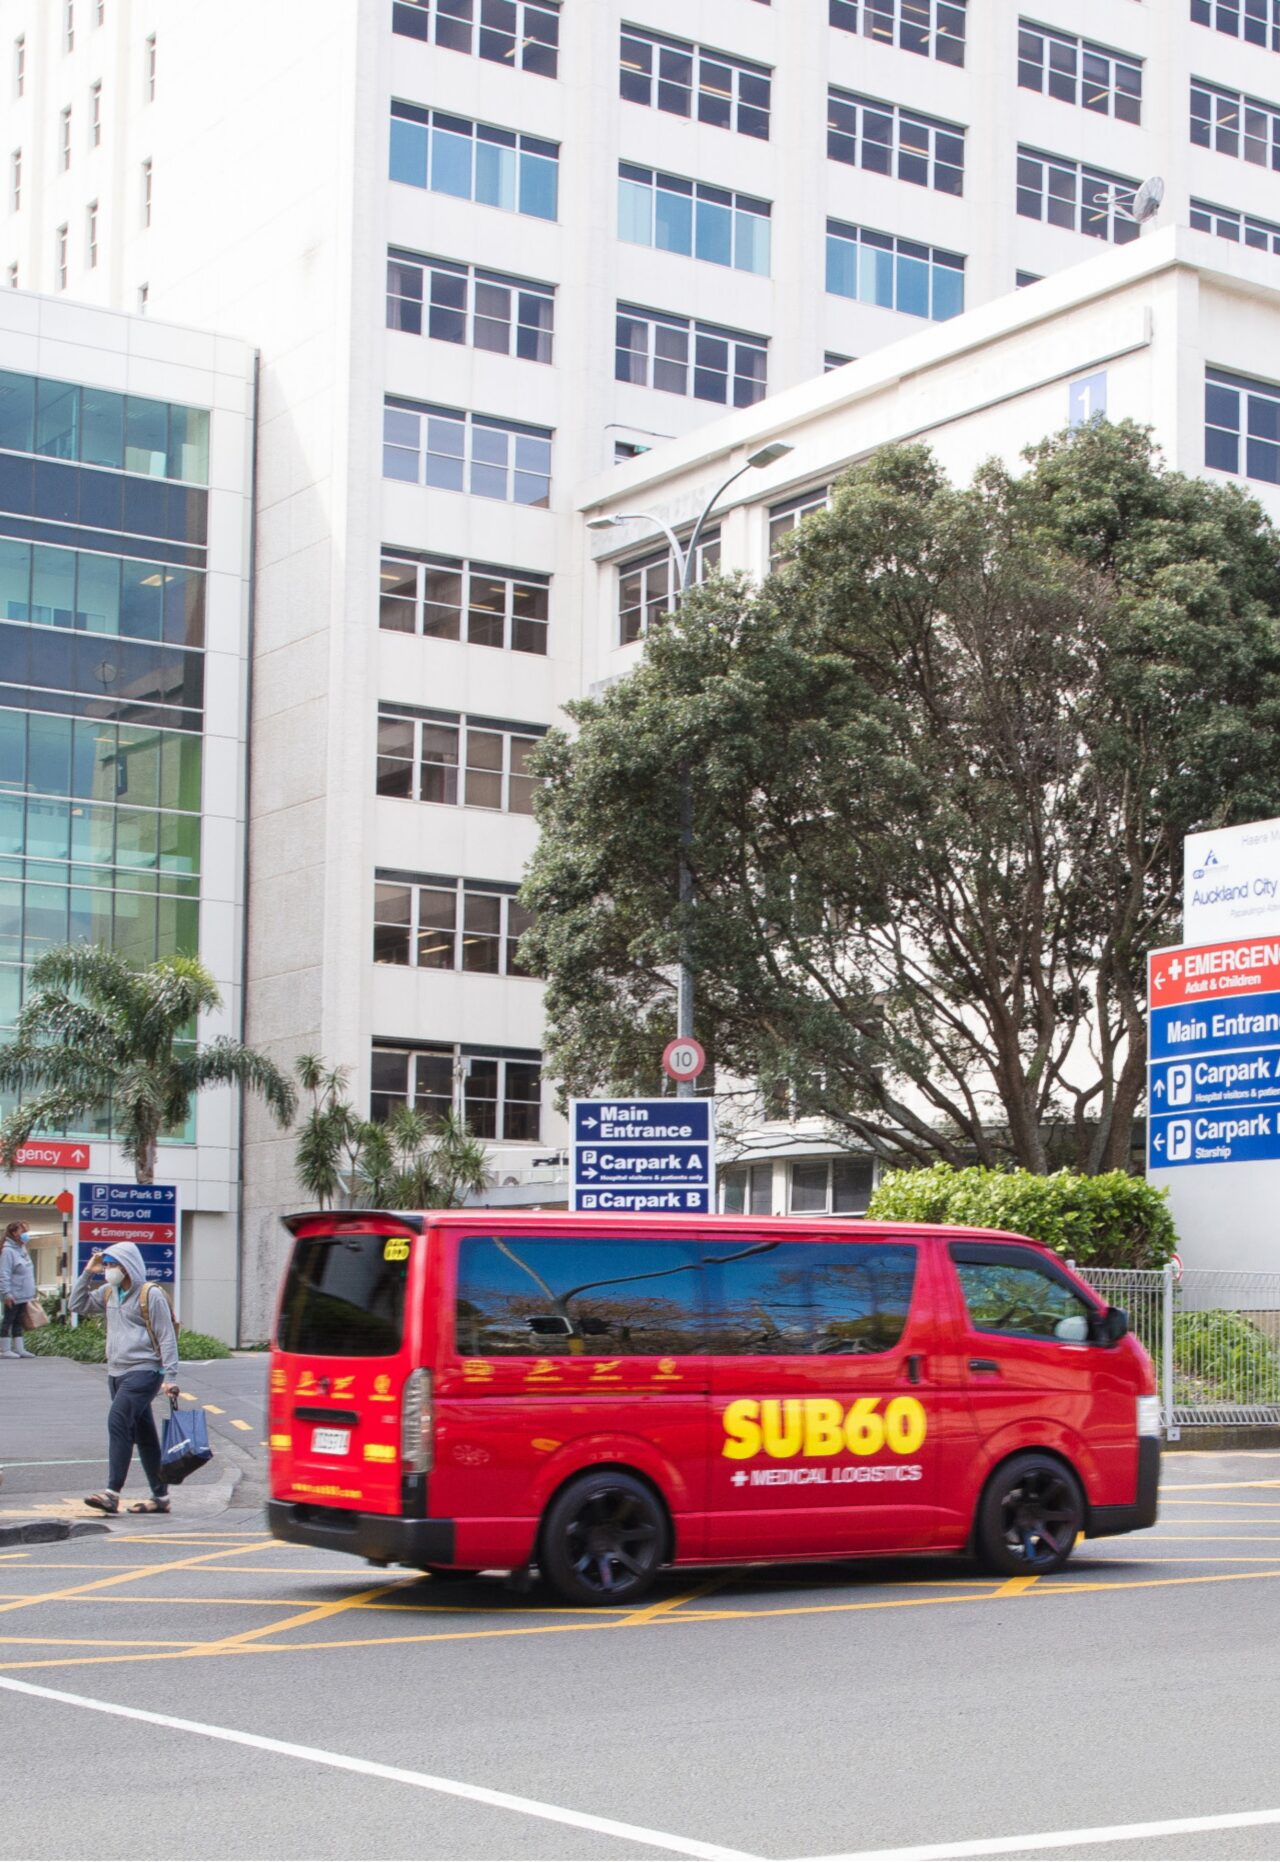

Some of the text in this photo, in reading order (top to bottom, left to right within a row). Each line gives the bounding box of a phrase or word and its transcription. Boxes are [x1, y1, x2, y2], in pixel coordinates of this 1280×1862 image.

[1078, 385, 1090, 422] 1
[1192, 882, 1249, 906] Auckland
[1253, 878, 1279, 898] City
[1185, 974, 1262, 994] Adult & Children
[1167, 1018, 1207, 1044] Main
[675, 1051, 693, 1068] 10
[1194, 1057, 1270, 1087] Carpark
[1223, 1089, 1249, 1099] visitors
[600, 1106, 649, 1121] Main
[600, 1123, 692, 1138] Entrance
[1194, 1113, 1271, 1143] Carpark
[15, 1148, 61, 1165] gency
[1195, 1145, 1232, 1160] Starship
[600, 1154, 682, 1173] Carpark
[687, 1154, 702, 1169] A
[110, 1189, 128, 1199] Car
[129, 1190, 152, 1199] Park
[154, 1191, 162, 1199] B
[599, 1192, 681, 1211] Carpark
[686, 1192, 701, 1207] B
[110, 1208, 135, 1220] Drop
[136, 1209, 151, 1218] Off
[101, 1227, 155, 1240] Emergency
[721, 1396, 927, 1460] SUB60
[750, 1465, 923, 1486] MEDICAL LOGISTICS
